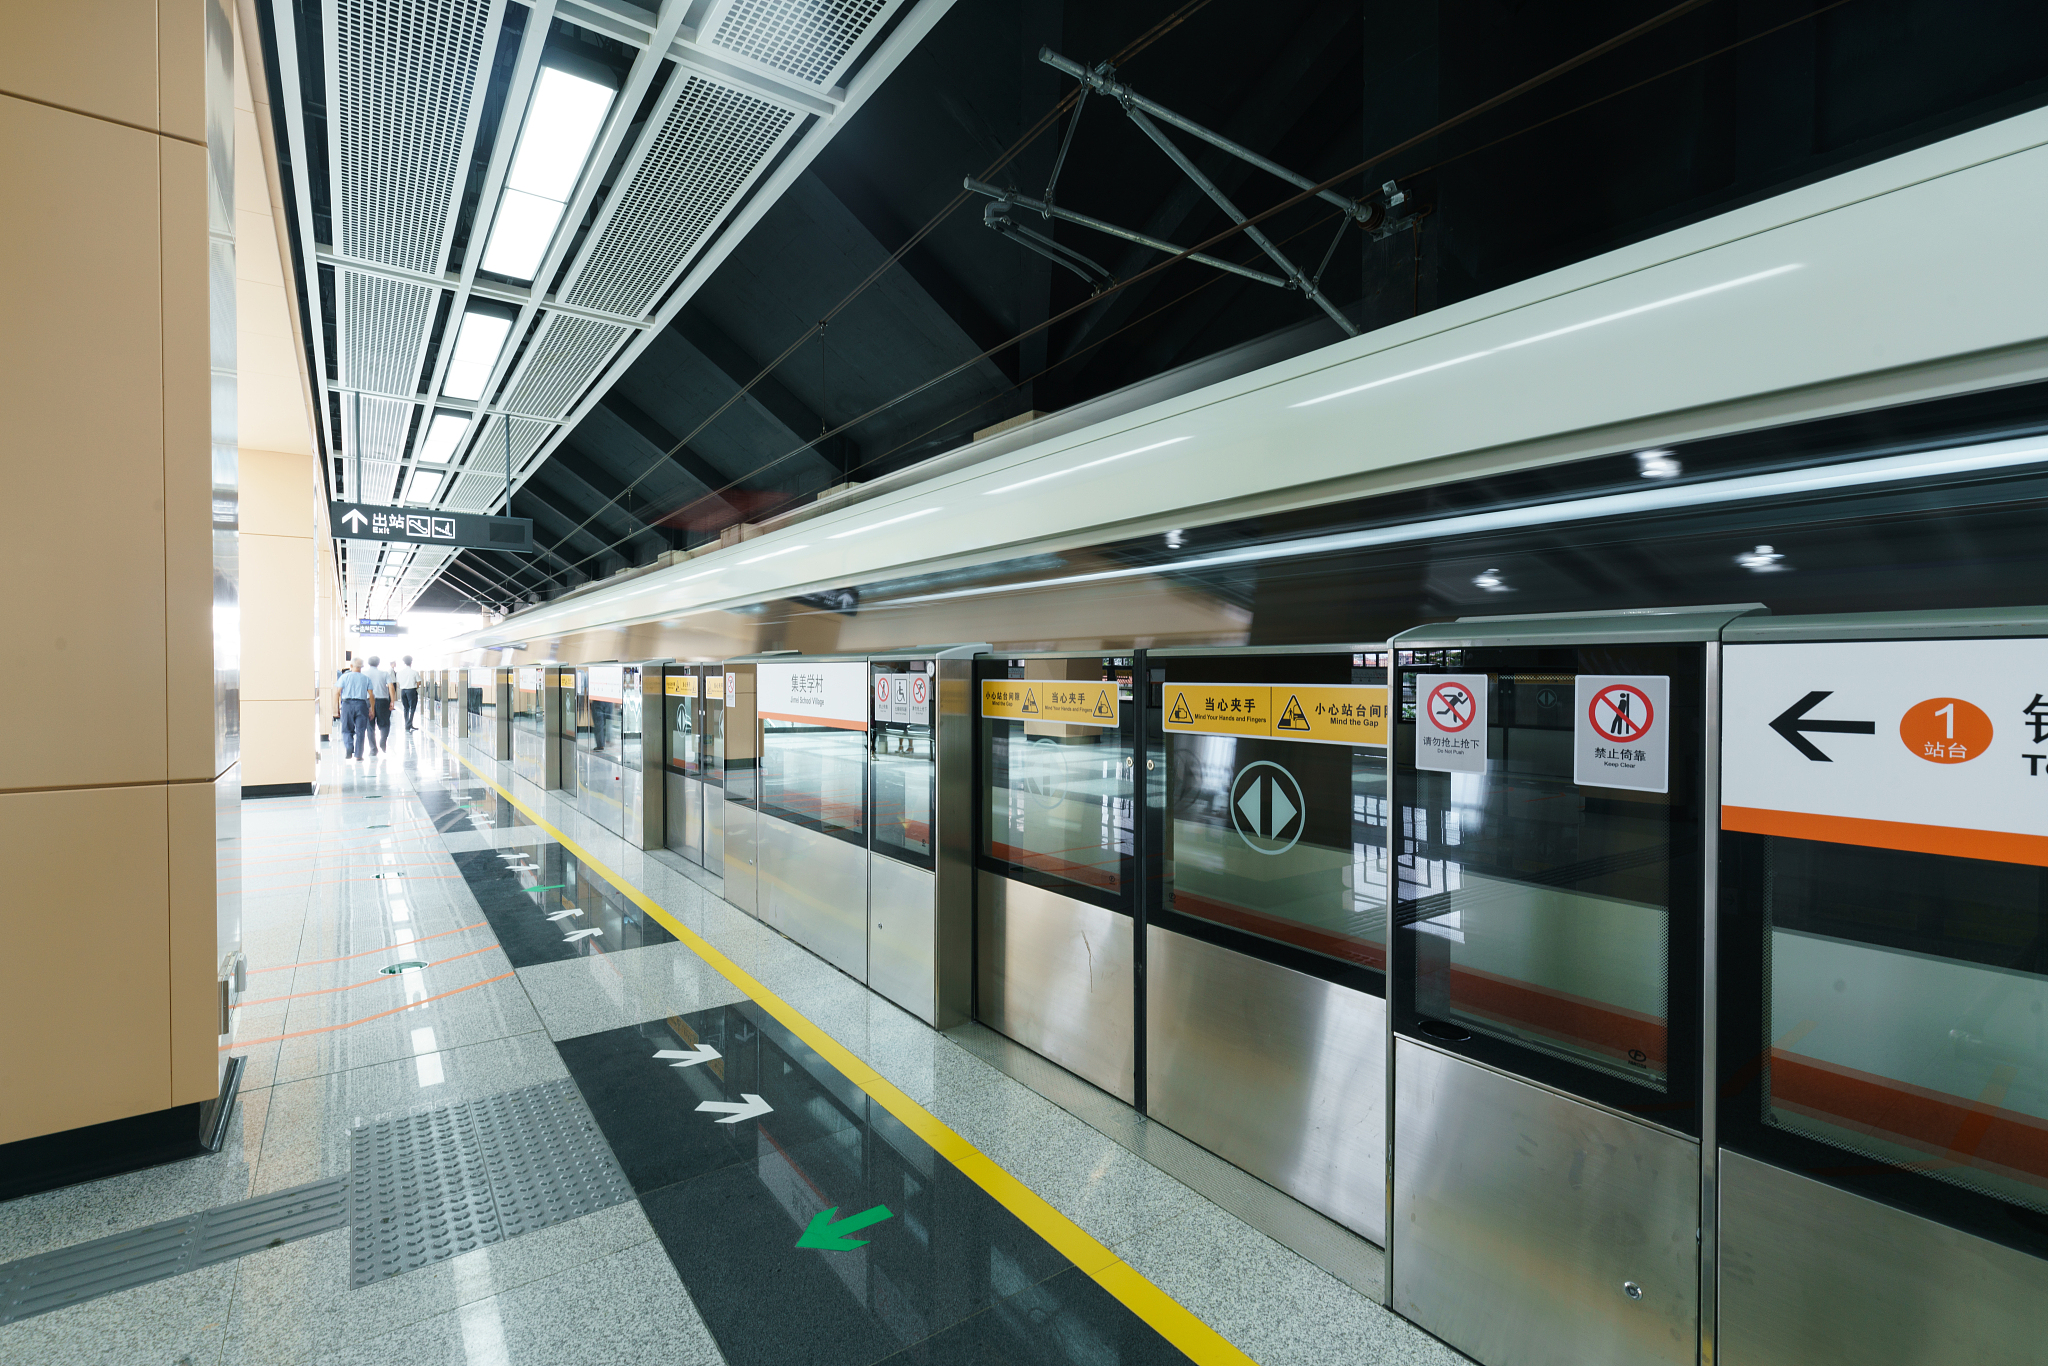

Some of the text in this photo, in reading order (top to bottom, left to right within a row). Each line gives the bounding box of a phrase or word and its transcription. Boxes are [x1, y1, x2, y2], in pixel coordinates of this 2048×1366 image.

[373, 512, 405, 529] 出站
[373, 526, 390, 534] Exit
[791, 673, 824, 693] 集美学村
[800, 696, 811, 704] School
[812, 697, 825, 707] Village
[1051, 692, 1086, 705] 当心夹手
[1205, 697, 1256, 713] 当心夹手
[1246, 716, 1267, 724] Fingers
[1330, 717, 1379, 728] Mind the Gap
[1934, 703, 1954, 739] 1
[1423, 736, 1480, 749] 请勿抢上抢下
[1594, 747, 1647, 761] 禁止倚靠
[1924, 741, 1968, 759] 站台
[1620, 761, 1636, 769] Clear
[2022, 753, 2048, 776] T
